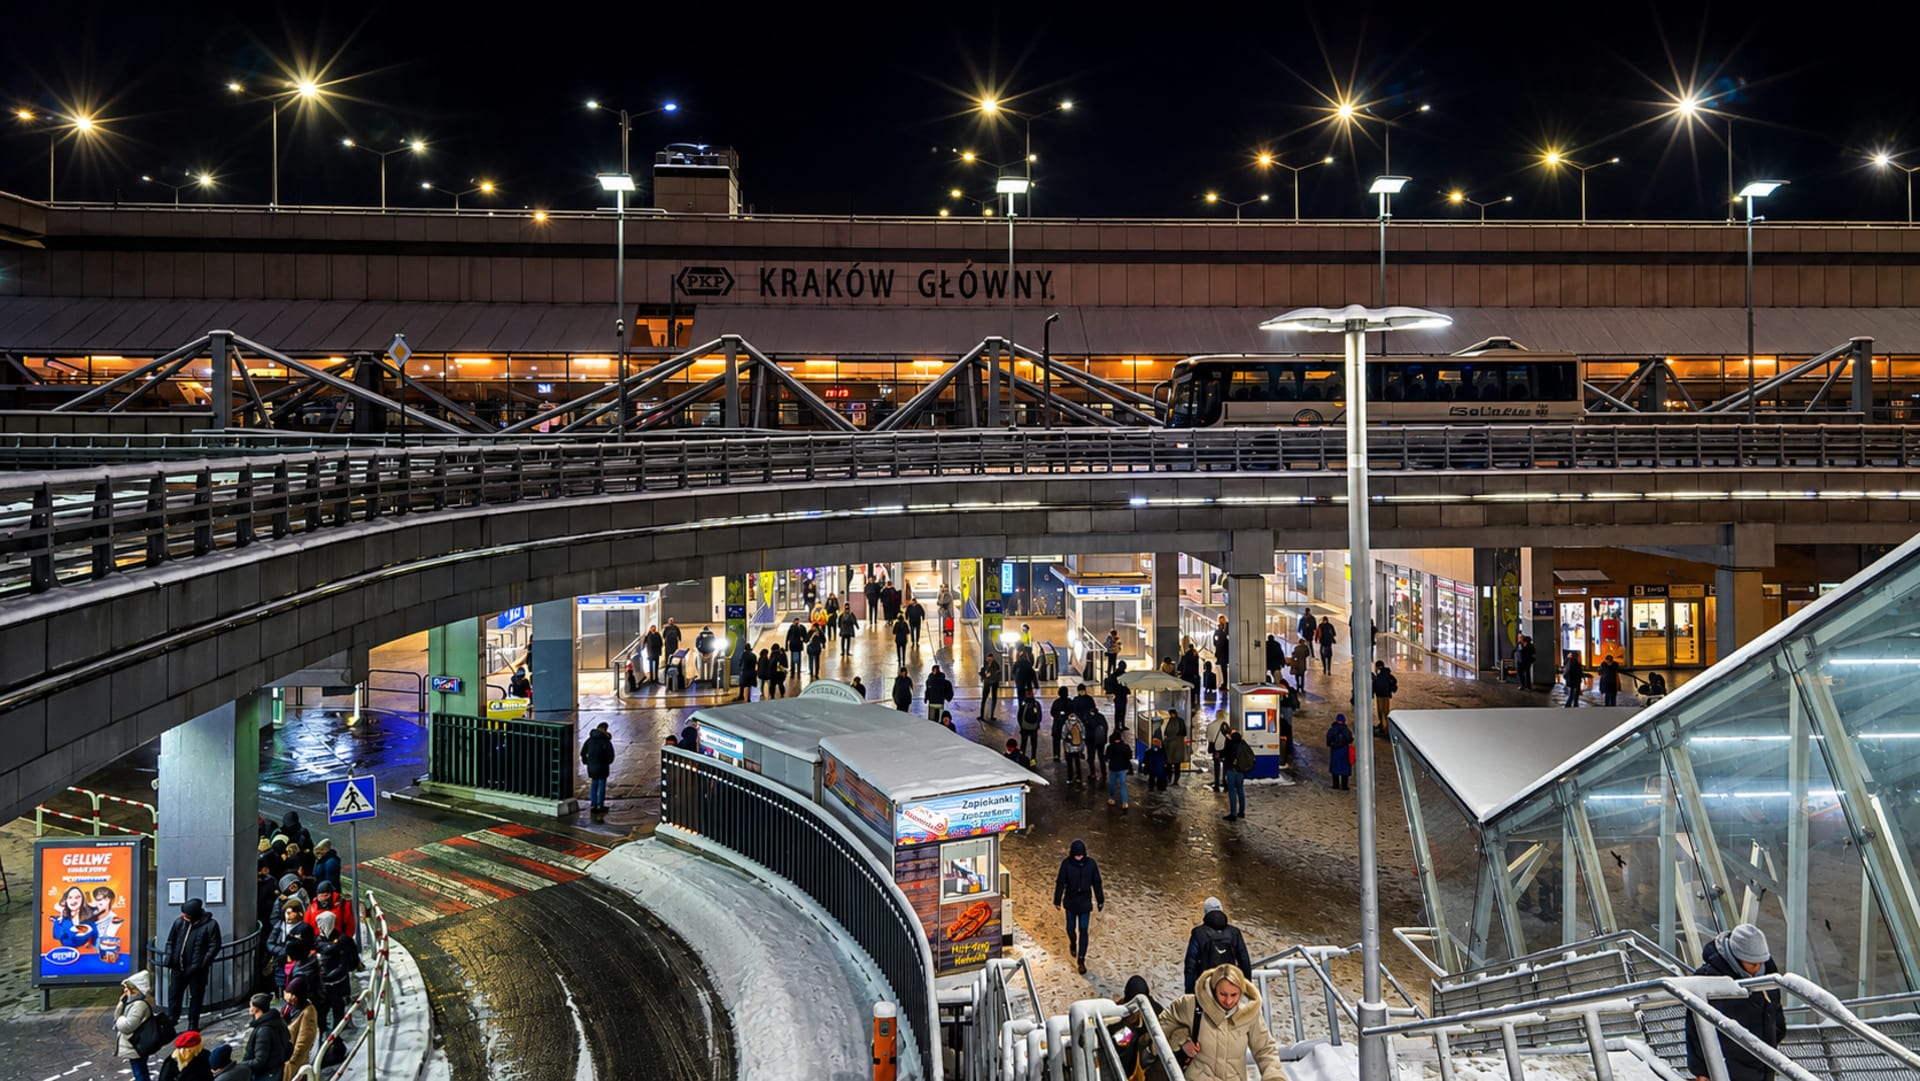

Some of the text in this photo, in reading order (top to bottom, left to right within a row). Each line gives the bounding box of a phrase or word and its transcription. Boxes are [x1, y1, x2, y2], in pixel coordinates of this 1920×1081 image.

[687, 275, 725, 288] PKP
[760, 262, 895, 298] KRAKÓW
[62, 853, 113, 866] GELLWE
